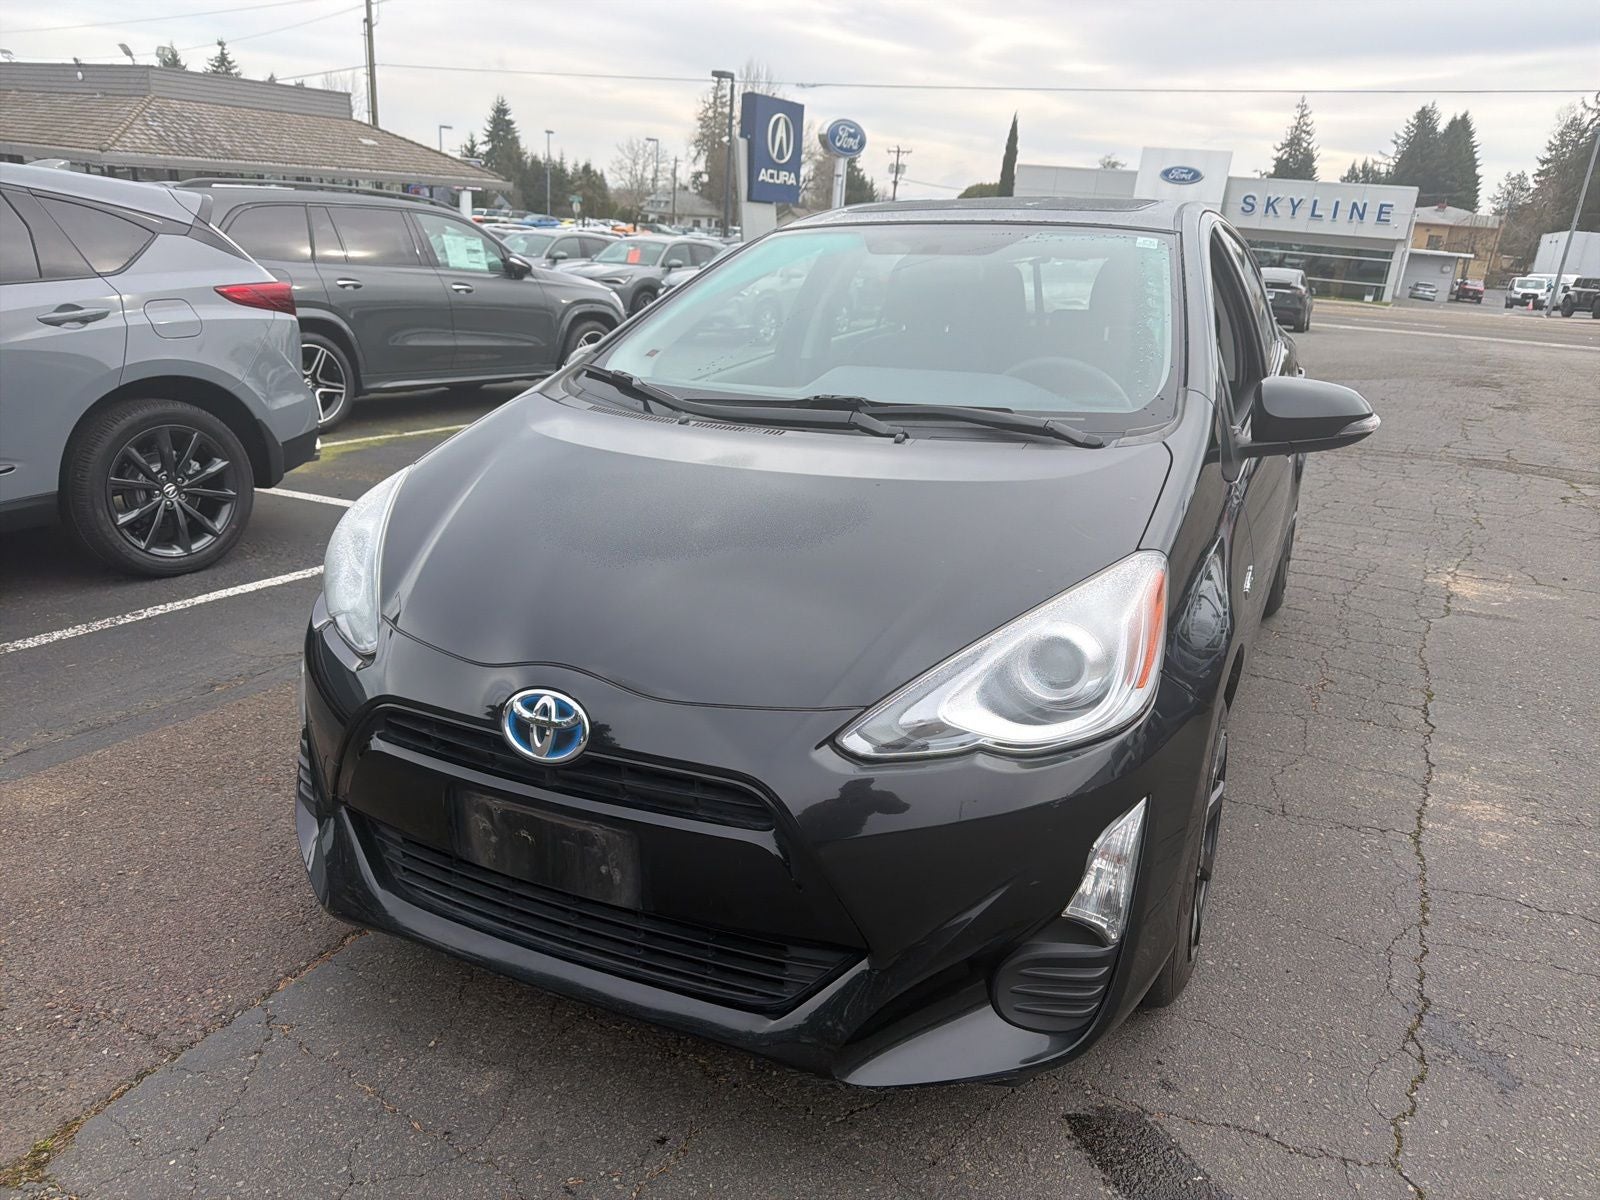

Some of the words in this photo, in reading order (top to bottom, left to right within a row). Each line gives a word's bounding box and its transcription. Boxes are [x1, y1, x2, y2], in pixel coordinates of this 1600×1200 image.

[835, 126, 861, 149] Ford
[758, 168, 796, 186] ACURA
[1168, 168, 1194, 181] Ford
[1240, 194, 1394, 224] SKYLINE
